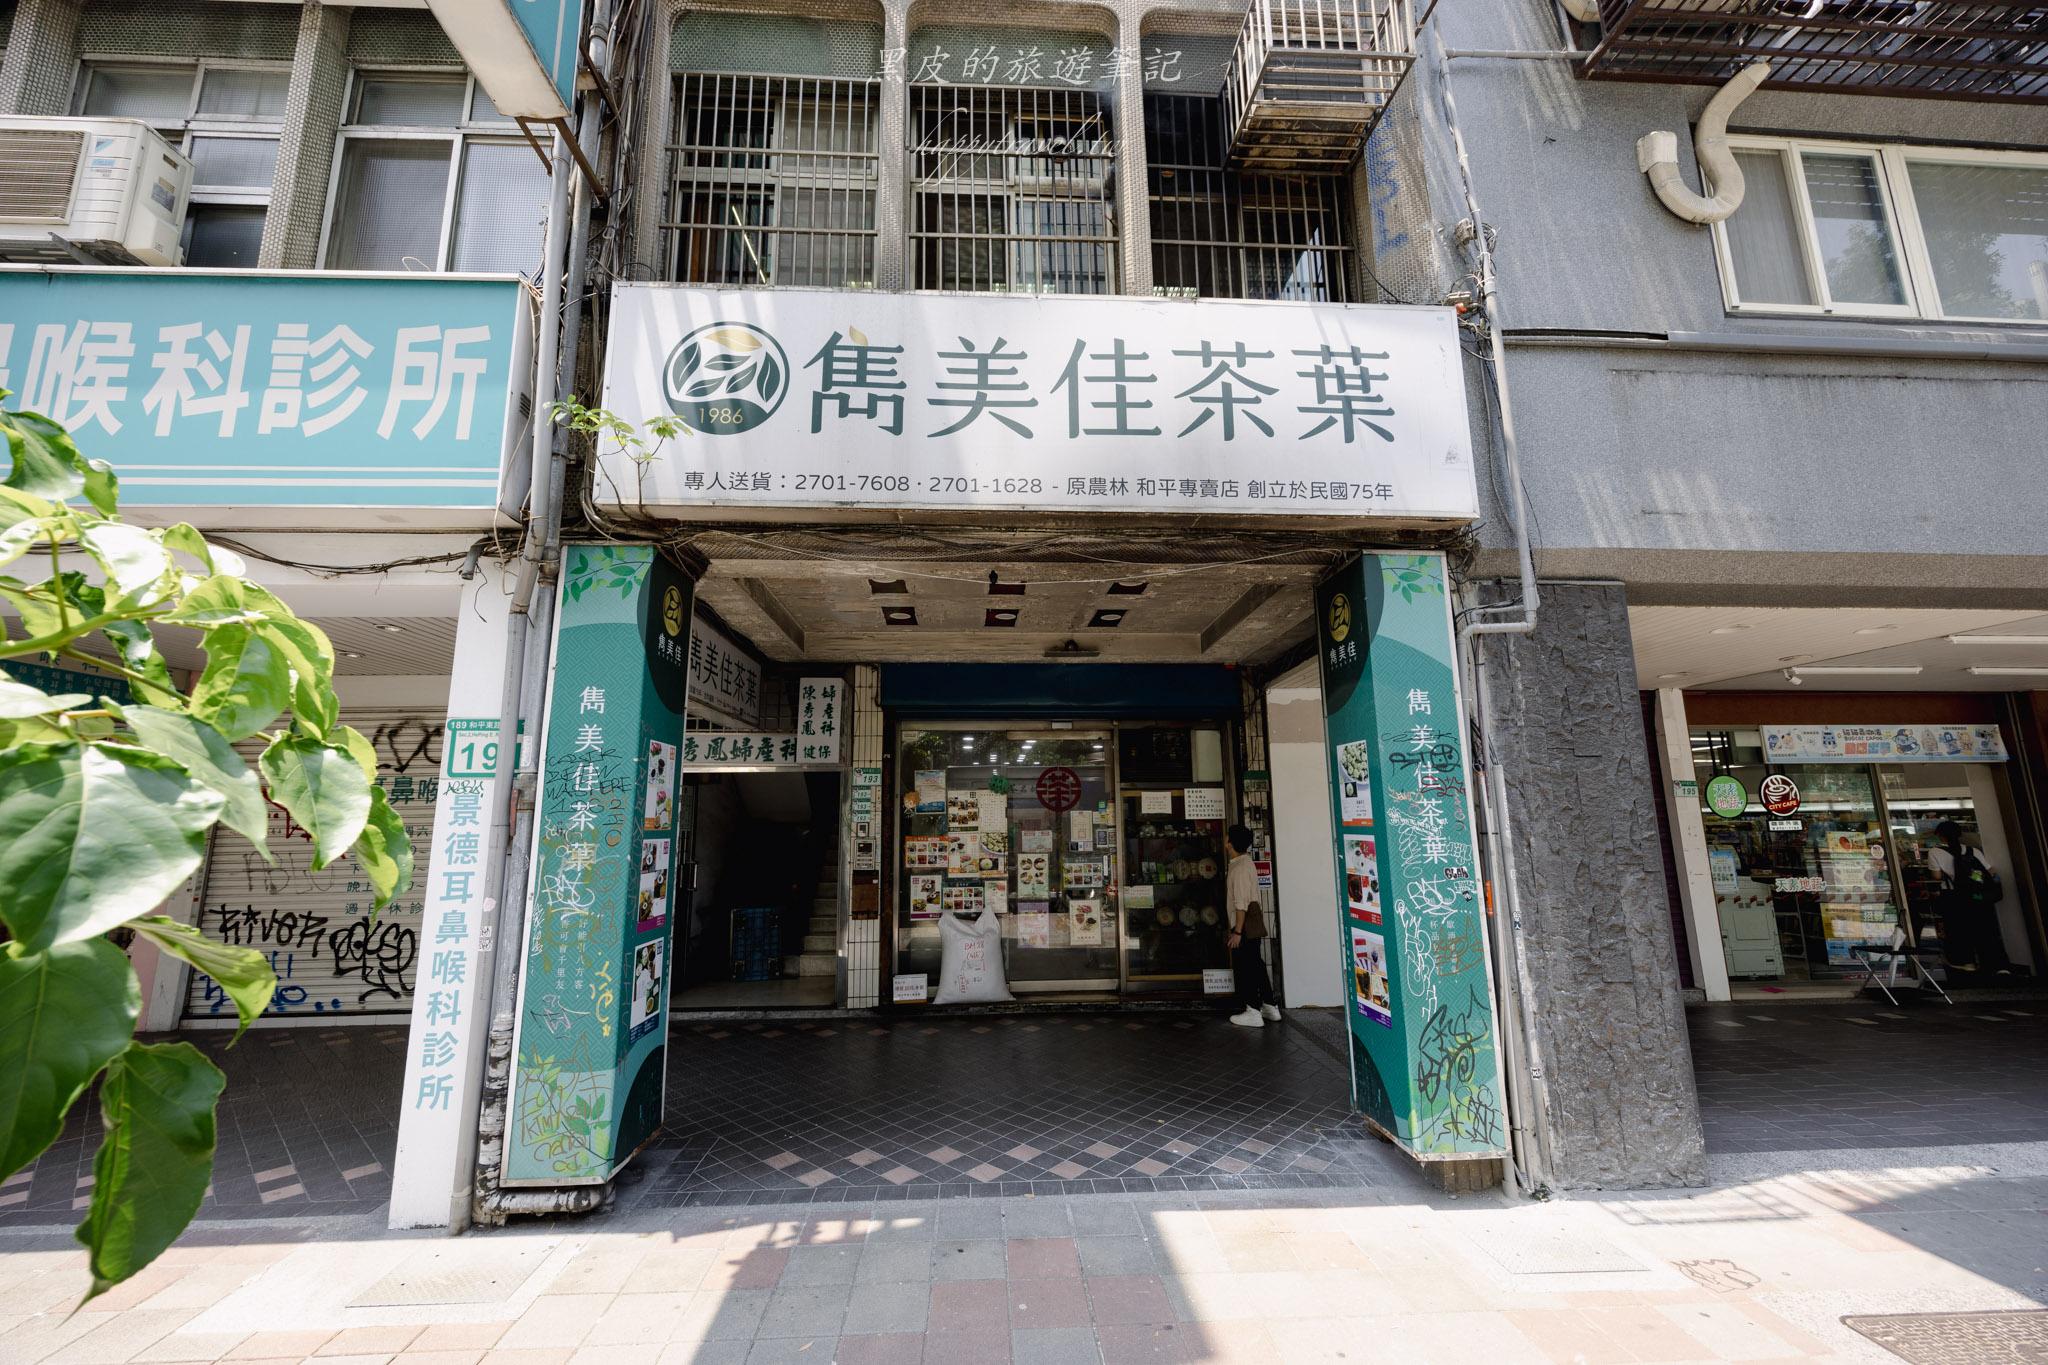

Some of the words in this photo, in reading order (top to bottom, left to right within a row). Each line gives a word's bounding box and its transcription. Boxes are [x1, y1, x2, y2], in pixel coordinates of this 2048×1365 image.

[803, 326, 1396, 444] 雋美佳茶葉
[698, 407, 744, 425] 1986
[1066, 477, 1129, 497] 原農林
[1137, 478, 1239, 499] 和平專賣店
[1248, 480, 1394, 501] 創立於民國75年
[801, 686, 817, 737] 陳秀鳳
[821, 685, 837, 737] 婦產科
[804, 745, 831, 759] 健保
[1406, 688, 1448, 865] 雋美佳茶葉
[565, 685, 606, 871] 雋美佳茶葉
[863, 775, 879, 783] 193
[1768, 803, 1783, 811] CITY
[415, 794, 481, 1111] 景德耳鼻喉科診所
